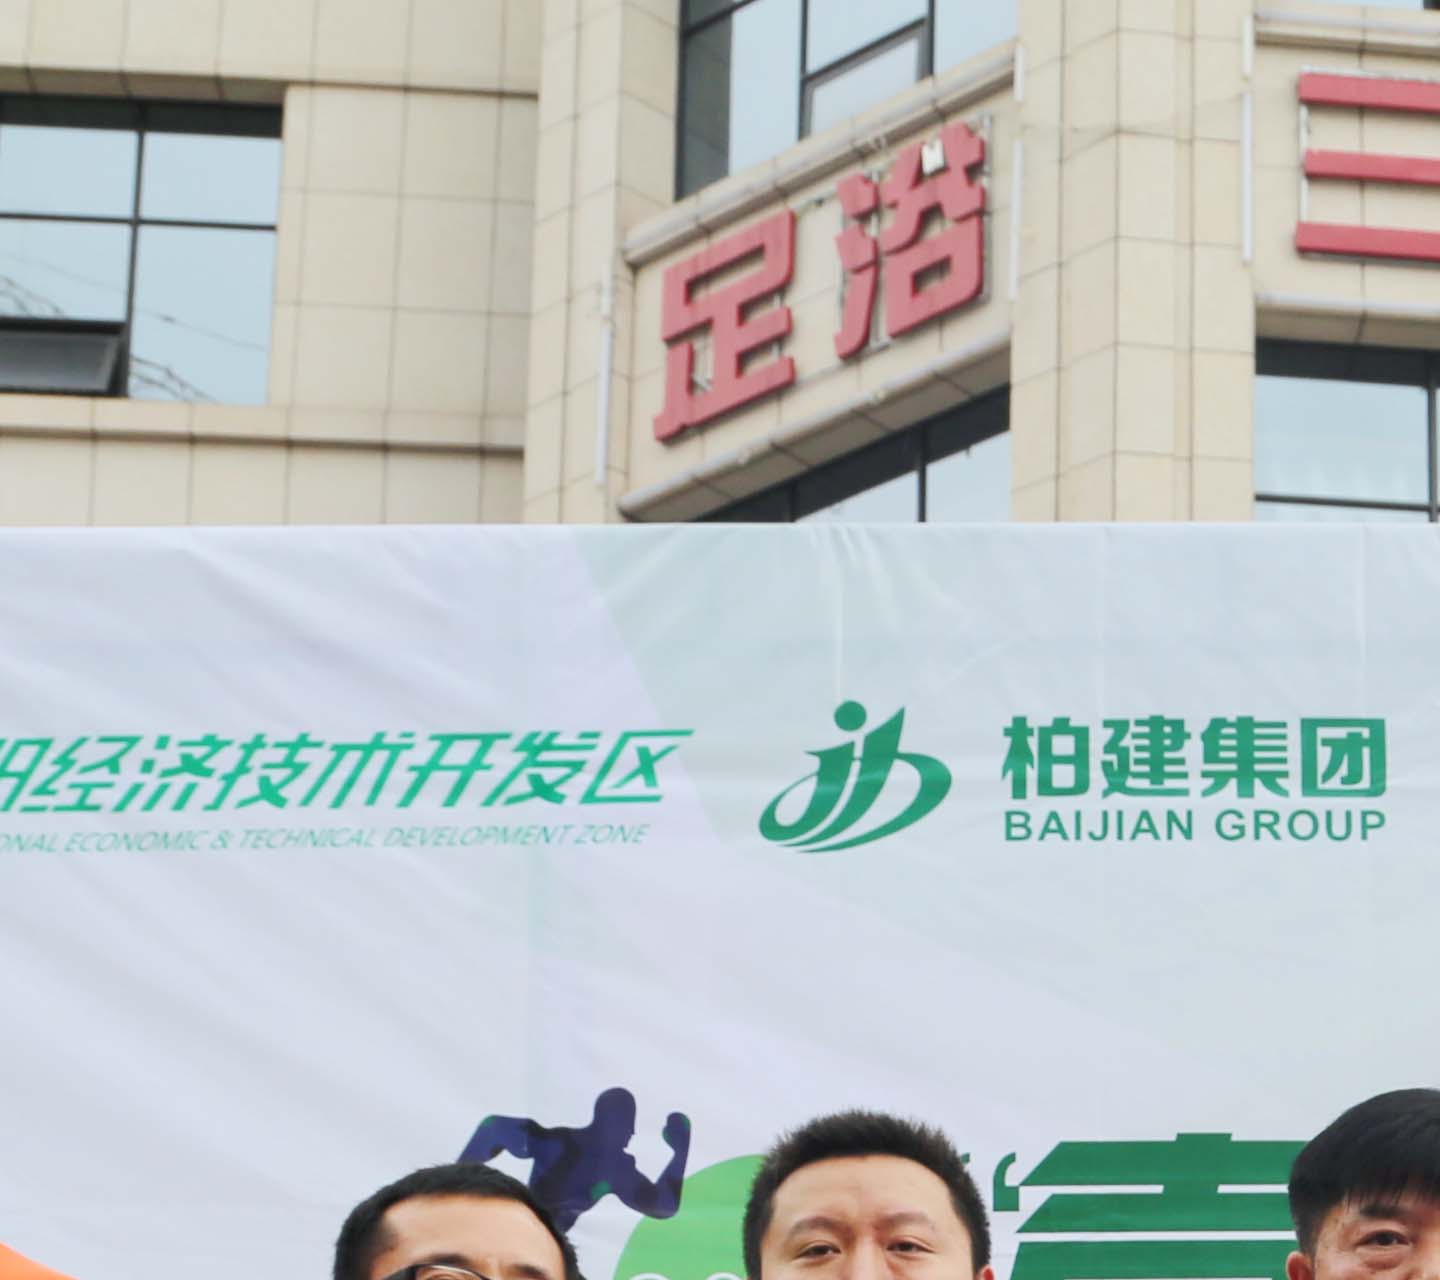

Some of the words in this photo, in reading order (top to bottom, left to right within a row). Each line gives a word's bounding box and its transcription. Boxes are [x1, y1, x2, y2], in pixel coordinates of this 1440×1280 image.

[1000, 714, 1387, 799] 柏建集团
[63, 831, 201, 852] ECONOMIC
[241, 828, 376, 850] TECHNICAL
[383, 825, 571, 848] DEVELOPMENT
[578, 823, 650, 845] ZONE
[1003, 809, 1194, 844] BAIJIAN
[1214, 808, 1388, 844] GROUP
